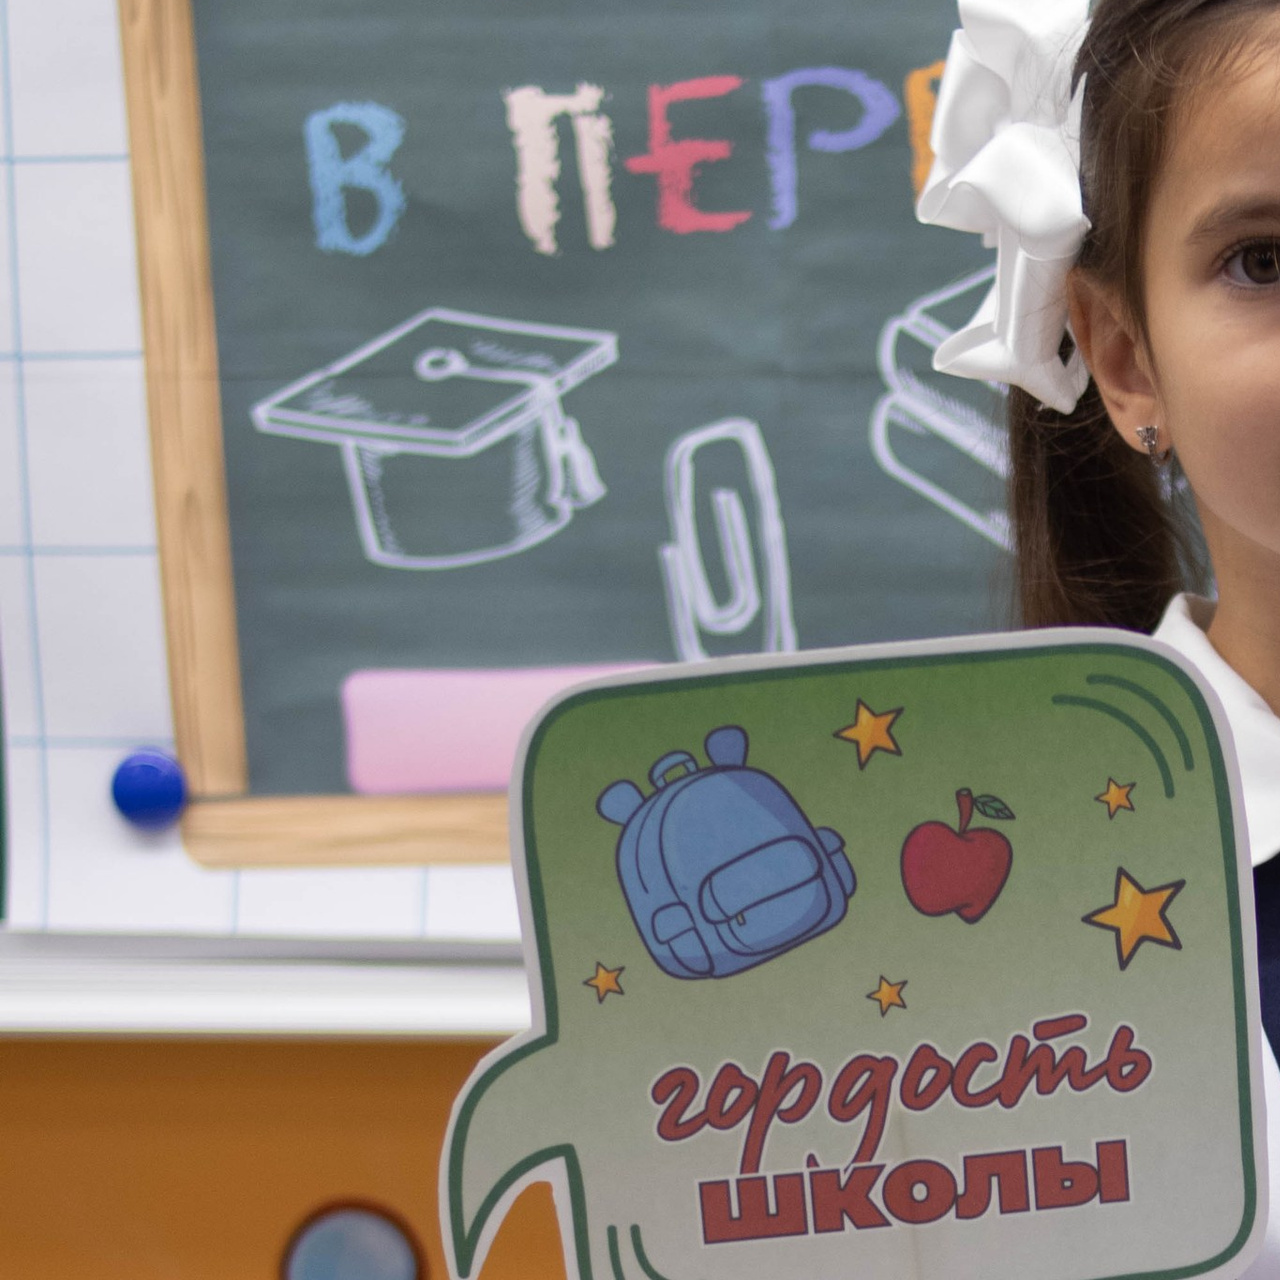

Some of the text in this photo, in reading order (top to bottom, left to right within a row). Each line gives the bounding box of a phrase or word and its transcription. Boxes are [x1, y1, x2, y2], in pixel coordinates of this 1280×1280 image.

[303, 100, 406, 256] В
[651, 1013, 1153, 1174] гордость
[698, 1138, 1131, 1245] школы
